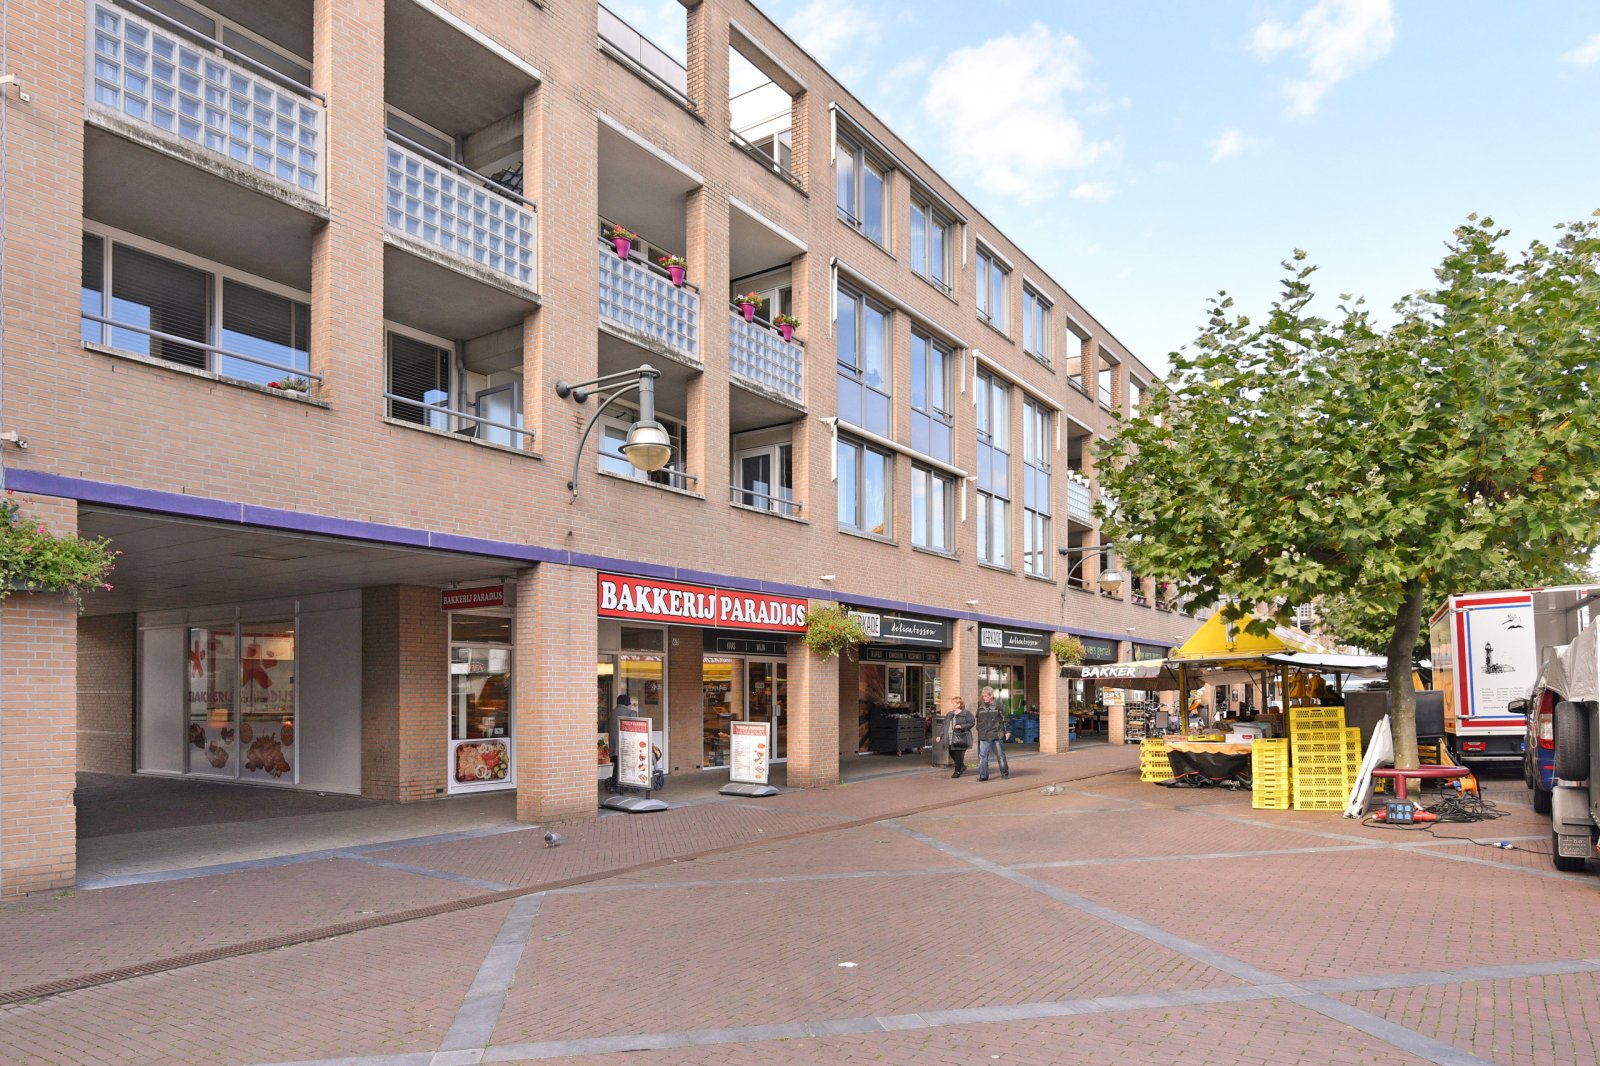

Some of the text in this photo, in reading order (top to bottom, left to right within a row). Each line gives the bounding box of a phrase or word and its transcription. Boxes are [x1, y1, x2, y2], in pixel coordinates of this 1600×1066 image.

[443, 591, 503, 605] BAKKERIJ PARADIJS
[600, 581, 806, 627] BAKKERIJ PARADIJS
[1081, 667, 1136, 678] BAKKER
